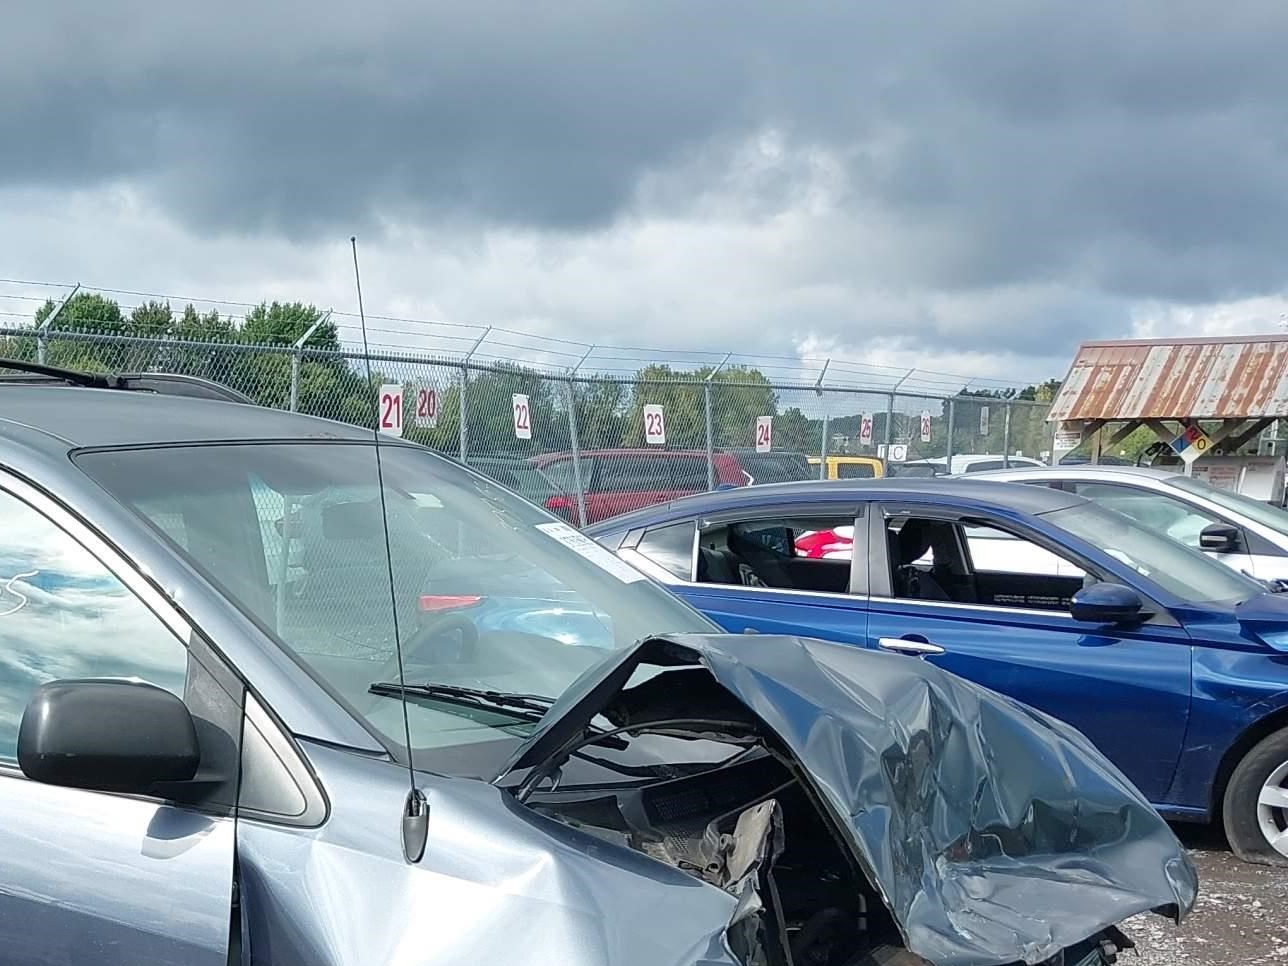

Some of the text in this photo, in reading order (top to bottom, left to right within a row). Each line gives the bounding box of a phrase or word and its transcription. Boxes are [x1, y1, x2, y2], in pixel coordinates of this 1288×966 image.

[382, 394, 400, 428] 21
[418, 389, 436, 418] 20
[515, 404, 529, 430] 22
[647, 413, 663, 436] 23
[861, 418, 872, 439] 25
[758, 424, 770, 446] 24
